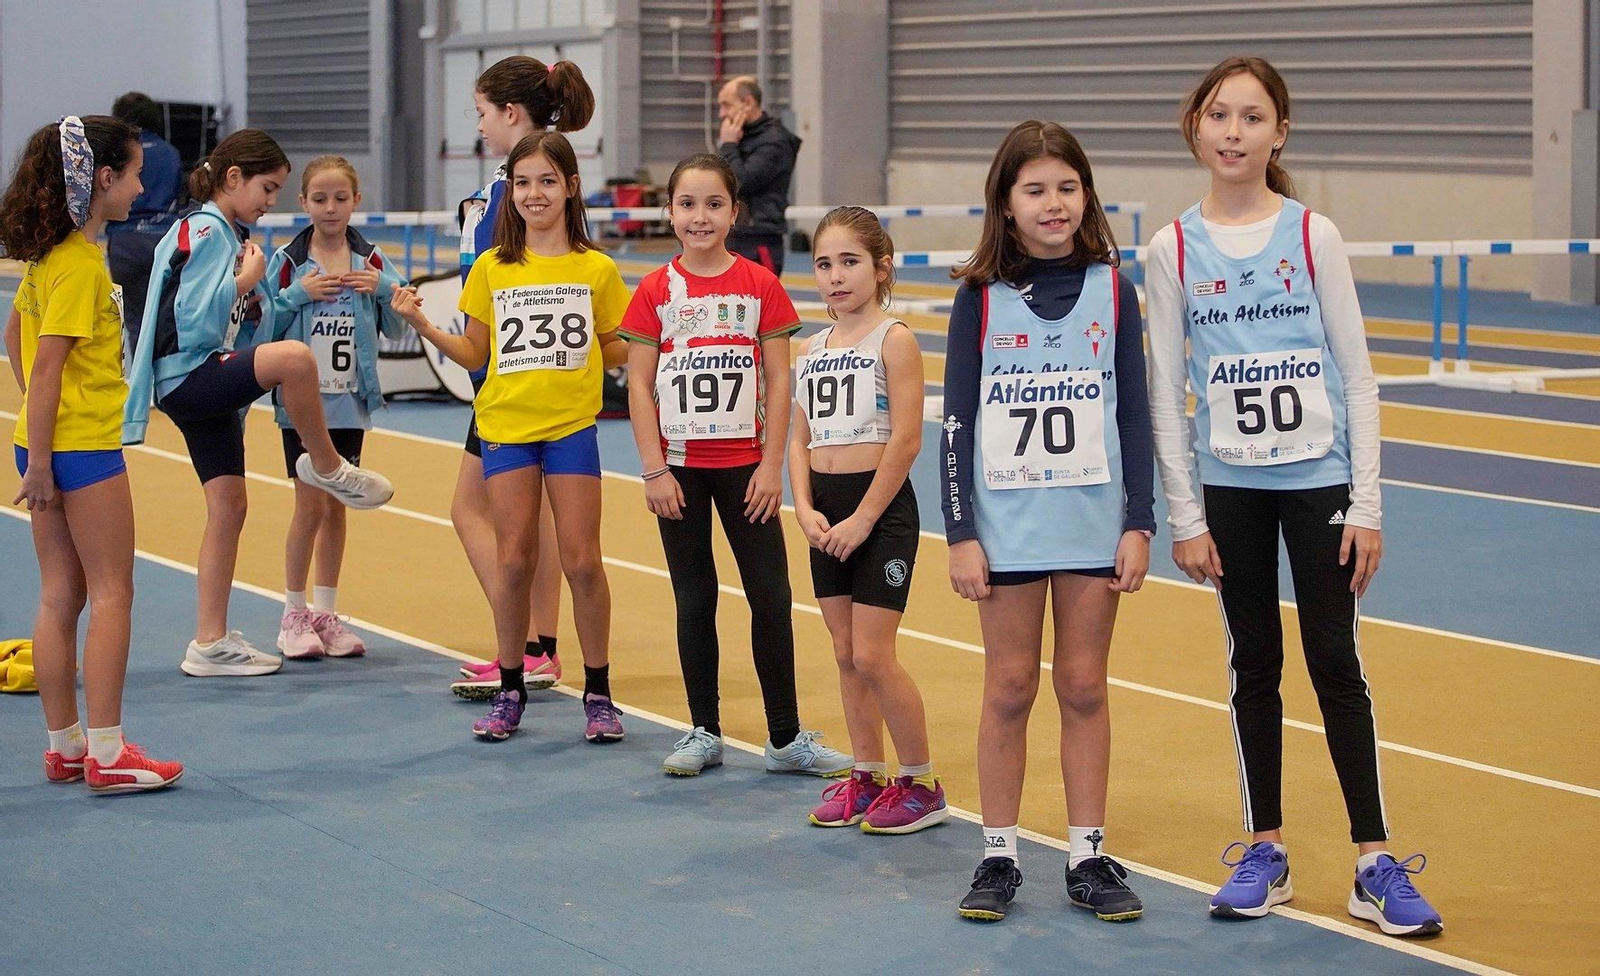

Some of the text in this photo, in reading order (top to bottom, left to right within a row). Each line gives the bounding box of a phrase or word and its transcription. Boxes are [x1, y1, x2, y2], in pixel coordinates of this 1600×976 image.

[512, 286, 588, 299] Federación Galega
[1239, 279, 1255, 287] ZICO
[523, 297, 565, 307] Atletismo
[500, 312, 589, 355] 238
[332, 340, 351, 372] 6
[498, 353, 555, 369] atletismo.gal
[661, 349, 754, 373] Atlántico
[1210, 355, 1321, 384] Atlántico
[671, 372, 743, 414] 197
[807, 374, 855, 420] 191
[986, 376, 1101, 405] Atlántico
[1233, 385, 1303, 435] 50
[1009, 406, 1075, 457] 70
[946, 452, 957, 478] CELTA
